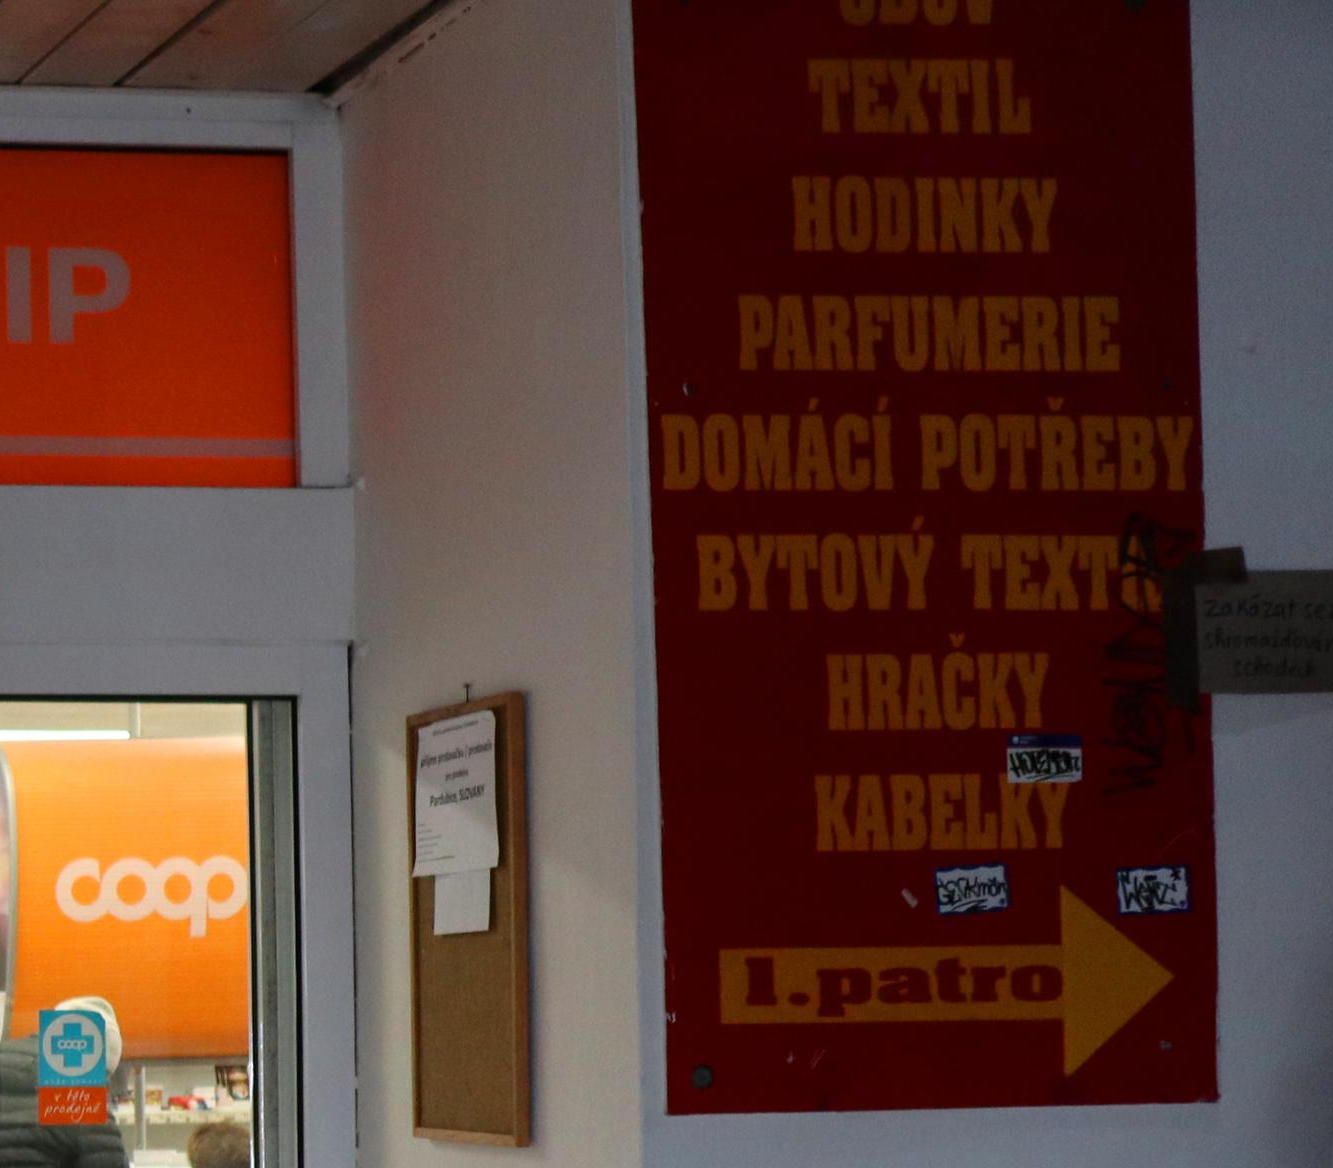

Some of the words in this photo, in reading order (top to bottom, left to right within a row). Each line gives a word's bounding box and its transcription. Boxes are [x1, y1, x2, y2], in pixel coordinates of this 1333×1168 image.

[808, 58, 1031, 135] TEXTIL
[792, 176, 1057, 253] HODINKY
[738, 295, 1122, 372] PARFUMERIE
[661, 397, 895, 491] DOMÁCÍ
[920, 399, 1195, 493] POTŘEBY
[696, 516, 933, 612] BYTOVÝ
[826, 633, 1050, 732] HRAČKY
[815, 773, 1070, 852] KABELKY
